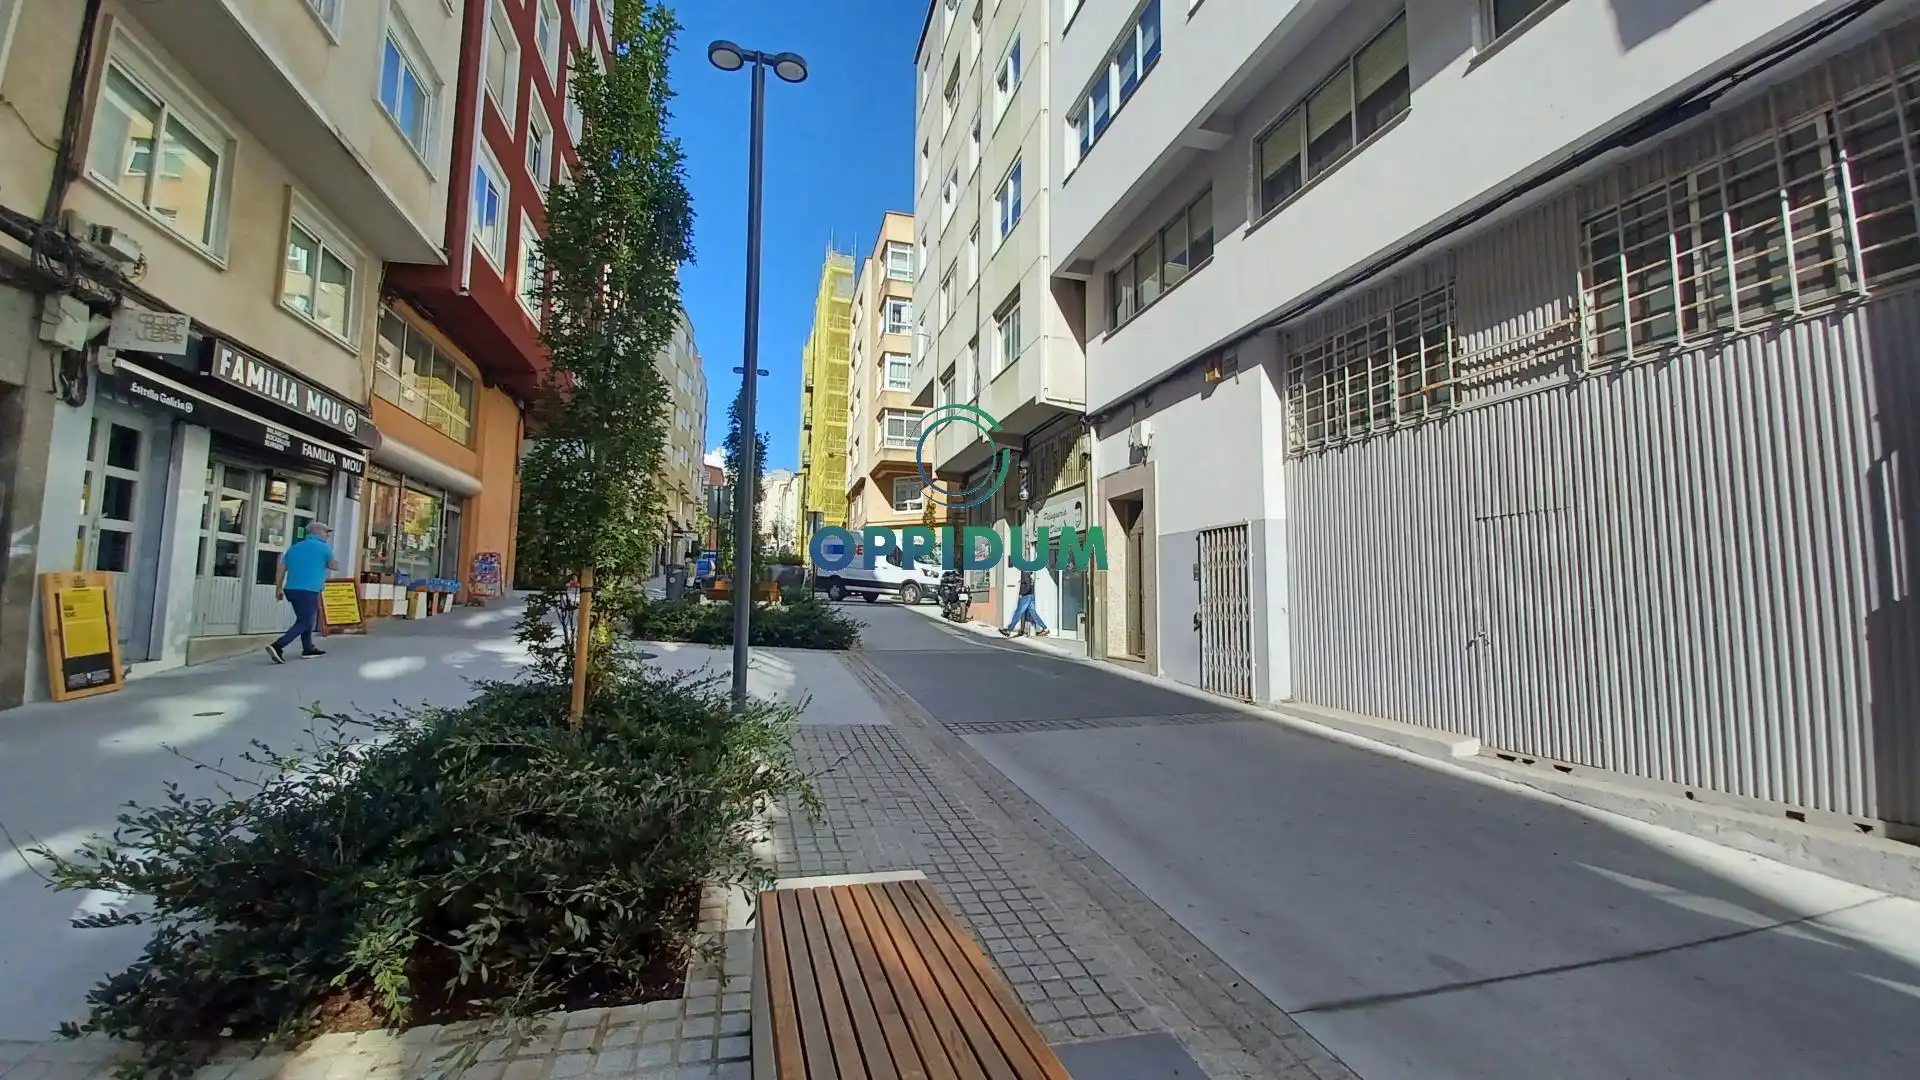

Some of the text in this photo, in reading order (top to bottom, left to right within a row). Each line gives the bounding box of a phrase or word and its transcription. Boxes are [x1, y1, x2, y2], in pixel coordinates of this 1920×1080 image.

[130, 382, 185, 410] Estrella Galicia
[219, 348, 342, 426] FAMILIA MOU
[301, 442, 363, 473] FAMILIA MOU
